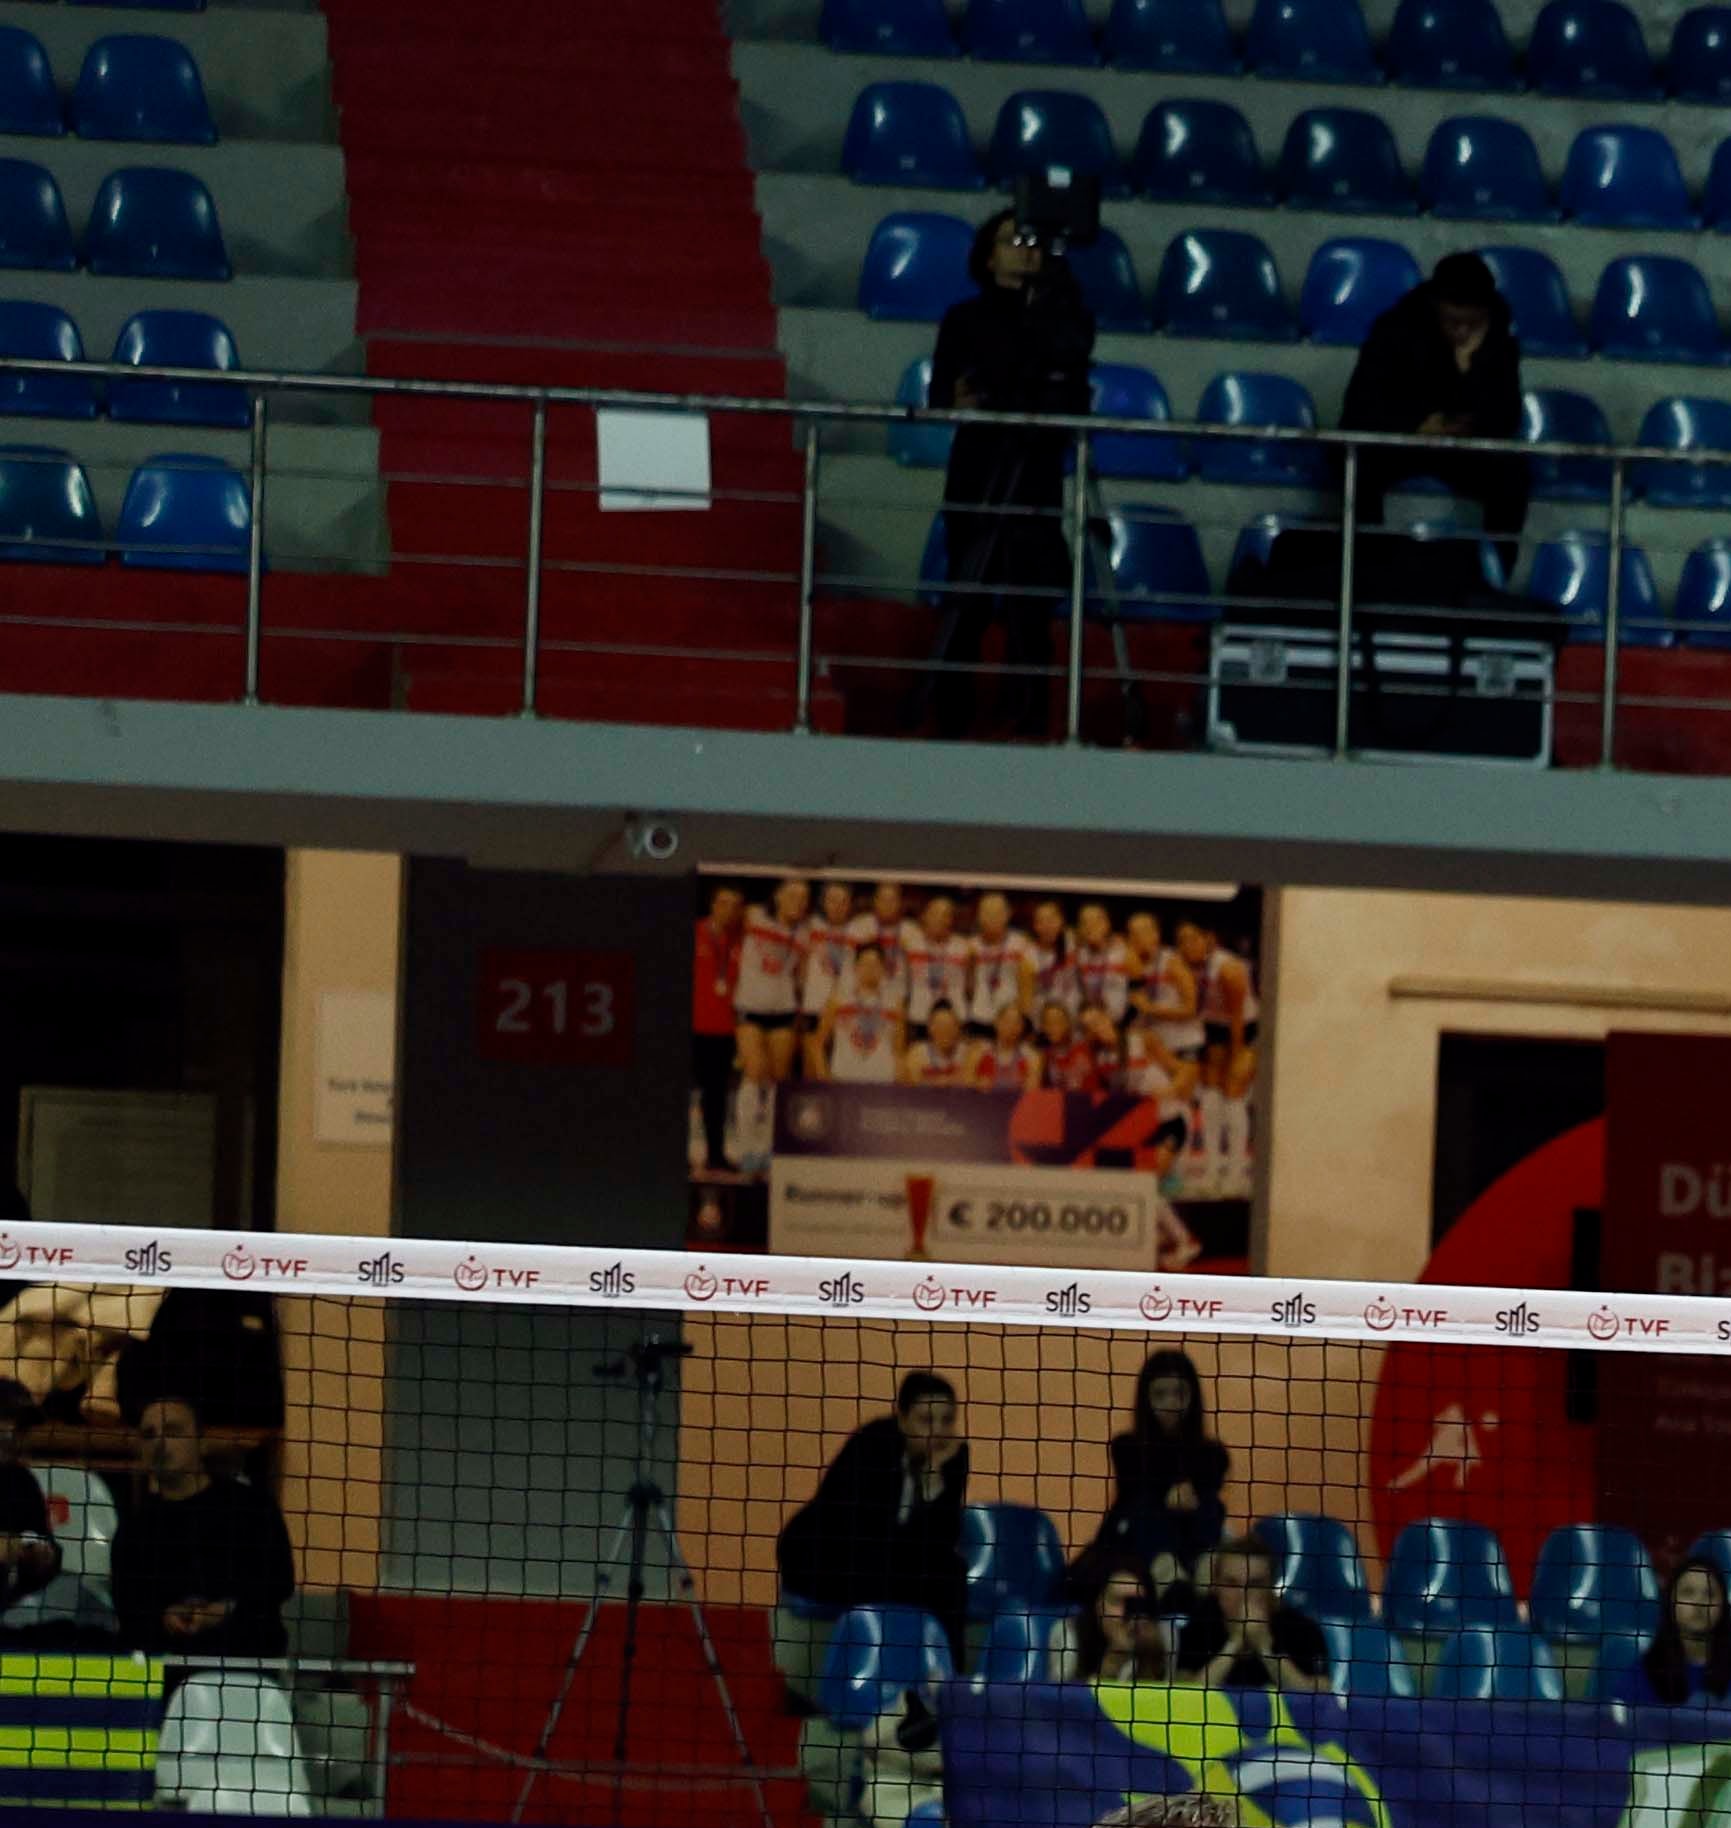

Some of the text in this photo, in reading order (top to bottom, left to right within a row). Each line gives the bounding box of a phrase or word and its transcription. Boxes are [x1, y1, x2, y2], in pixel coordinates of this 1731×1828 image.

[495, 978, 616, 1037] 213
[948, 1203, 1128, 1236] € 200.000
[26, 1247, 73, 1266] TVF
[124, 1239, 172, 1273] SMS
[259, 1257, 307, 1276] TVF
[358, 1250, 405, 1284] SMS
[492, 1268, 540, 1287] TVF
[589, 1260, 635, 1294] SMS
[721, 1278, 769, 1297] TVF
[818, 1271, 865, 1305] SMS
[950, 1289, 997, 1308] TVF
[1046, 1281, 1091, 1315] SMS
[1176, 1299, 1222, 1318] TVF
[1271, 1291, 1316, 1325] SMS
[1400, 1308, 1447, 1327] TVF
[1495, 1301, 1540, 1334] SMS
[1625, 1318, 1669, 1337] TVF
